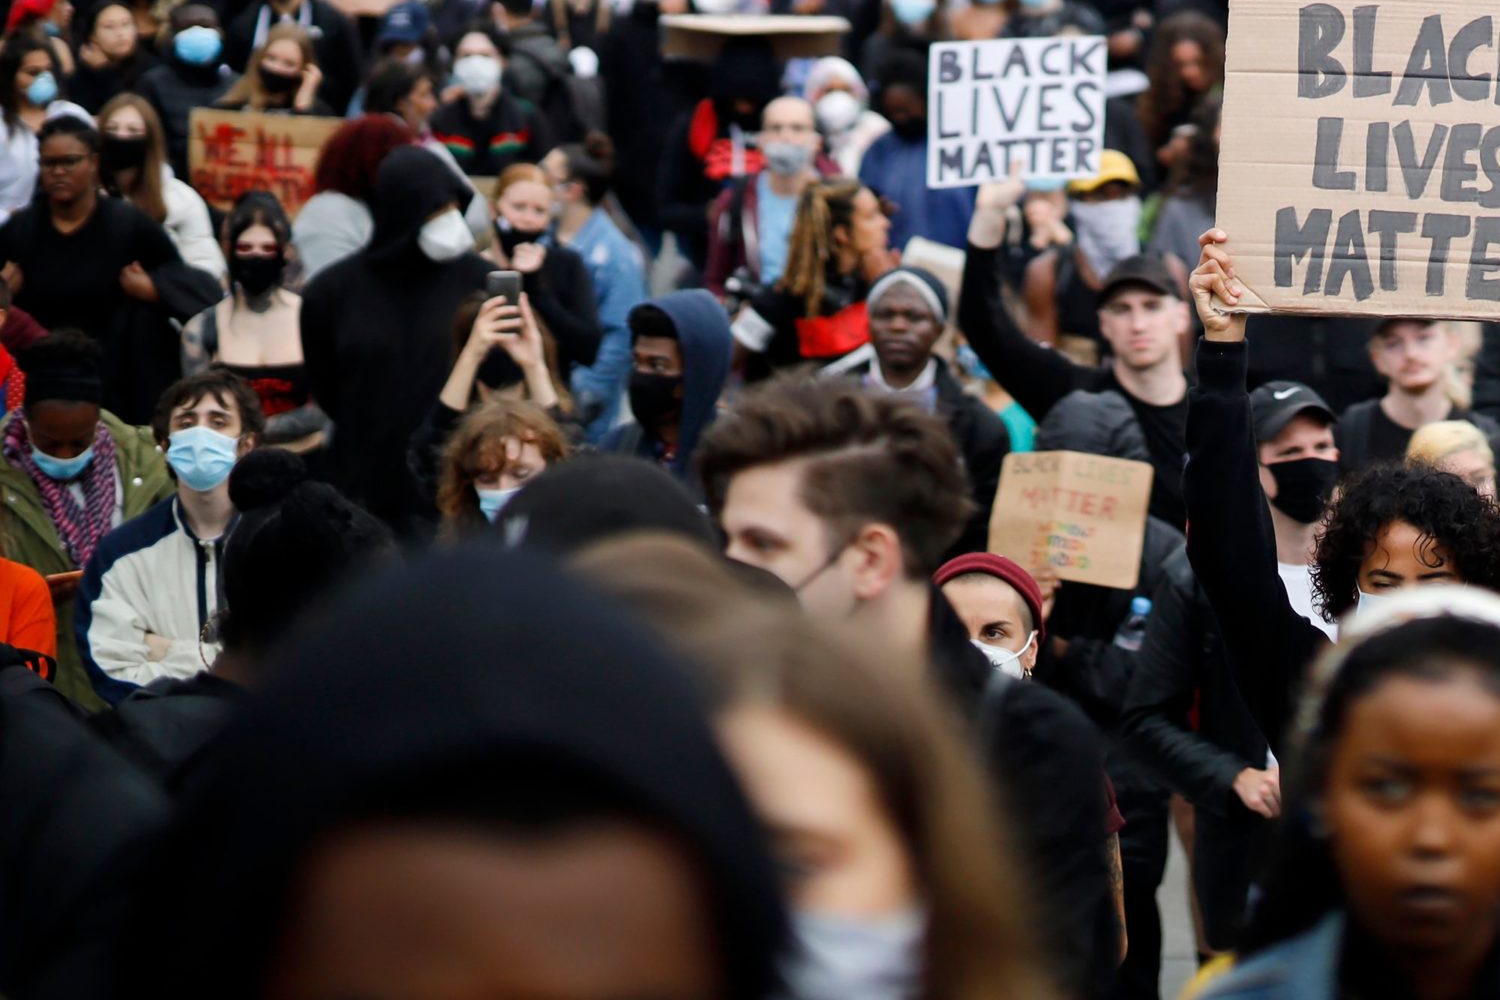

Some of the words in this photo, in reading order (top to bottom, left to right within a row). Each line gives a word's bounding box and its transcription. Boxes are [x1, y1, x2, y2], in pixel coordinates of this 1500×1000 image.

[938, 42, 1106, 83] BLACK
[936, 82, 1099, 139] LIVES
[937, 137, 1096, 182] MATTER
[1012, 455, 1062, 474] BLACK
[1073, 458, 1139, 485] LIVES
[1020, 486, 1120, 521] MATTER
